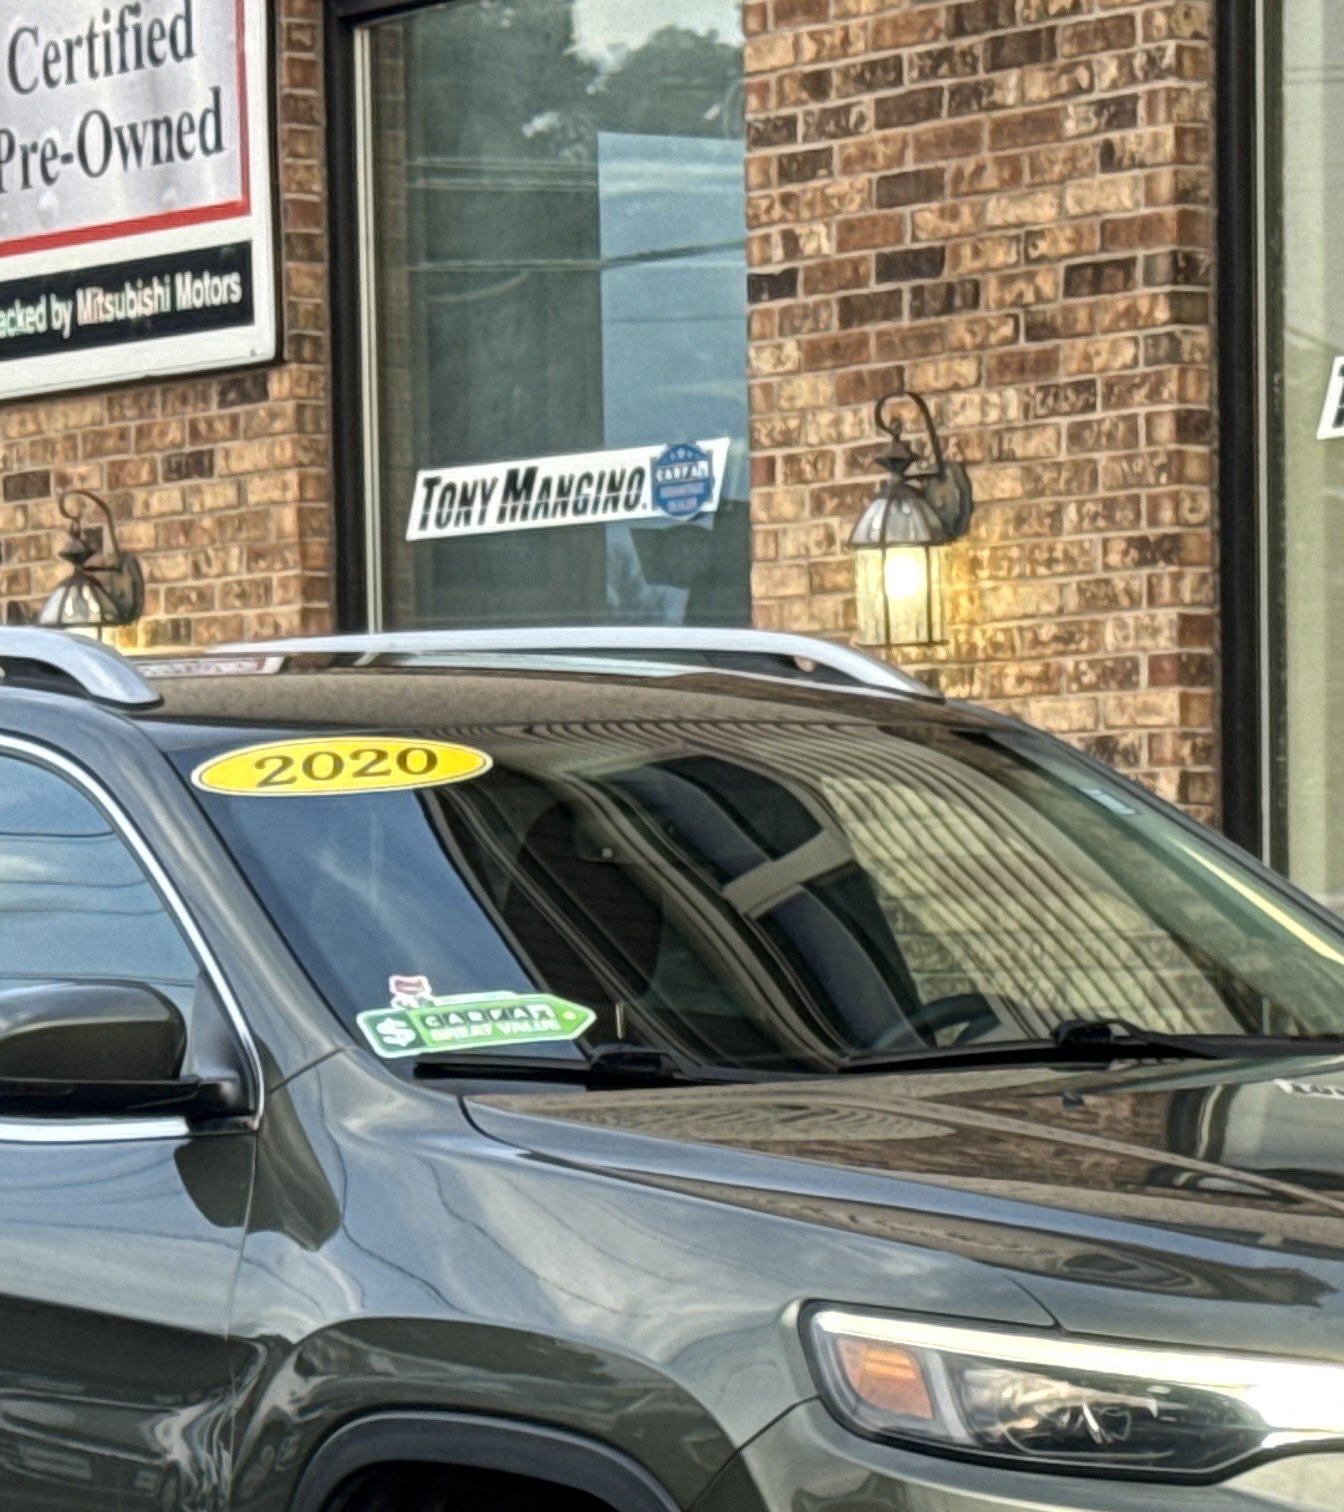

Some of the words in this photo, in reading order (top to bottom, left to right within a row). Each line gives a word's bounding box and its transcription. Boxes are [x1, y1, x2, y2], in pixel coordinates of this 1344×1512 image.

[6, 0, 197, 95] Certified
[50, 291, 74, 339] by
[75, 276, 171, 326] Mitsubishi
[174, 270, 243, 312] Motors
[417, 475, 500, 532] TONY
[496, 465, 646, 525] MANGINO
[254, 746, 439, 789] 2020
